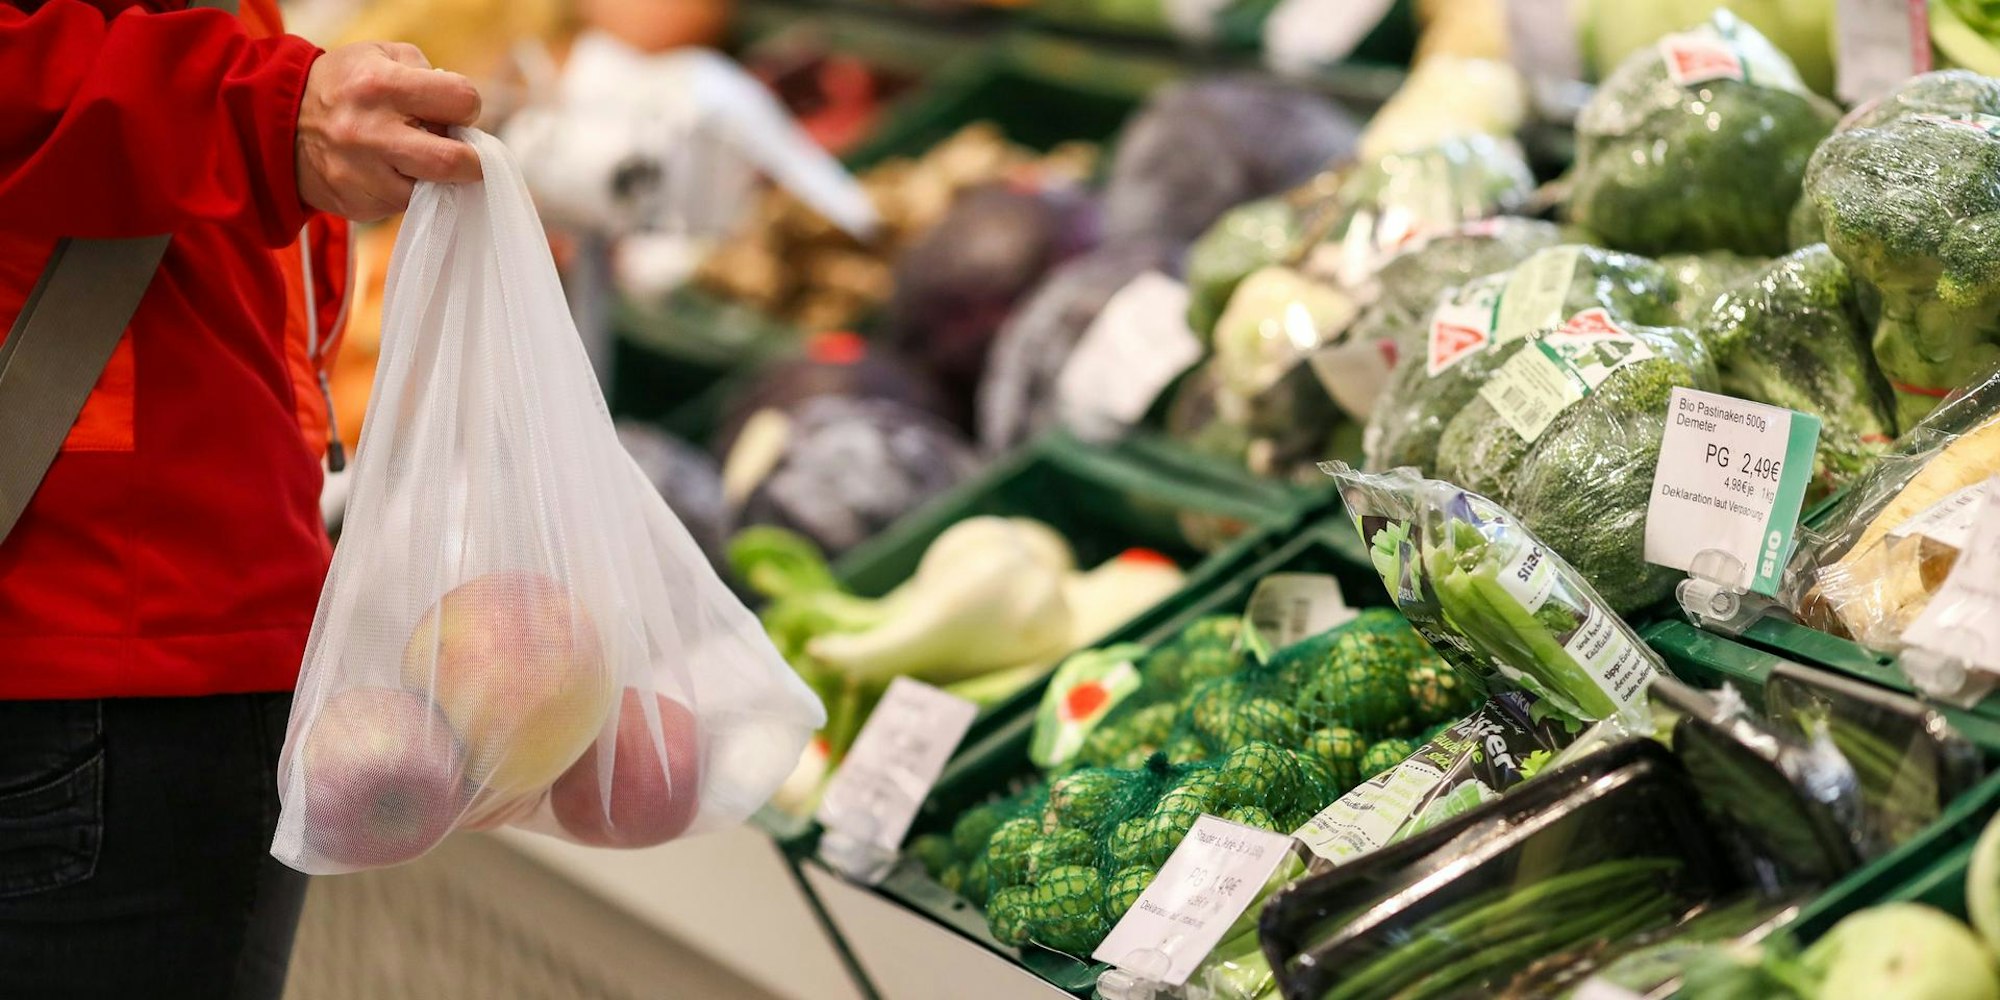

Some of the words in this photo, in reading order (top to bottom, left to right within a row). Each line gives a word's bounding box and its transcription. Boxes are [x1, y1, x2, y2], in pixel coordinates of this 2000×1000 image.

[1676, 413, 1717, 433] Demeter
[1679, 398, 1695, 412] Bio
[1697, 402, 1745, 423] Pastinaken
[1746, 414, 1766, 432] 500g
[1706, 443, 1730, 467] PG
[1741, 453, 1781, 482] 2,49€
[1662, 484, 1713, 506] Deklaration
[1713, 496, 1728, 510] laut
[1761, 530, 1782, 578] BIO
